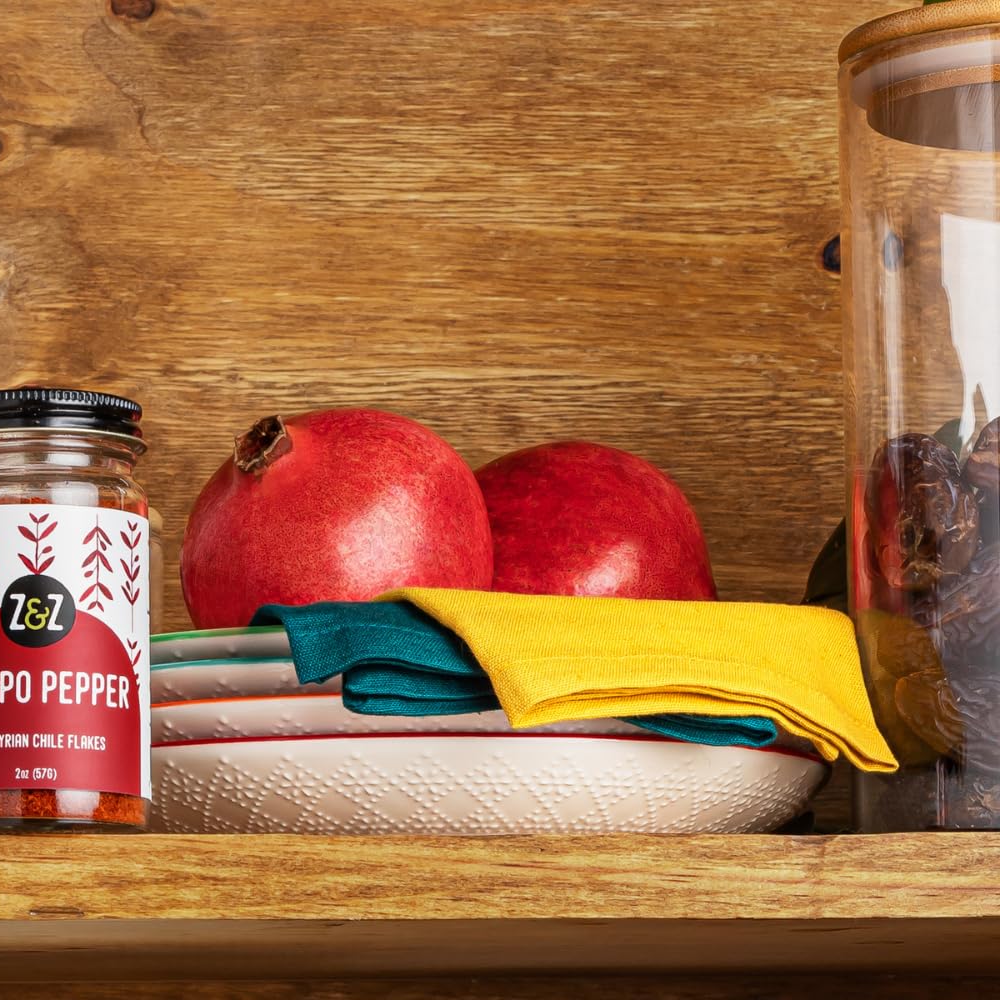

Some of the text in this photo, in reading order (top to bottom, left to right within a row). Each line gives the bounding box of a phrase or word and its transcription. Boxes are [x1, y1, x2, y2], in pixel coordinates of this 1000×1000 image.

[9, 593, 64, 631] Z&Z
[42, 671, 130, 709] PEPPER
[32, 733, 64, 748] CHILE
[67, 734, 106, 751] FLAKES
[14, 767, 57, 781] 2oz (57G)
